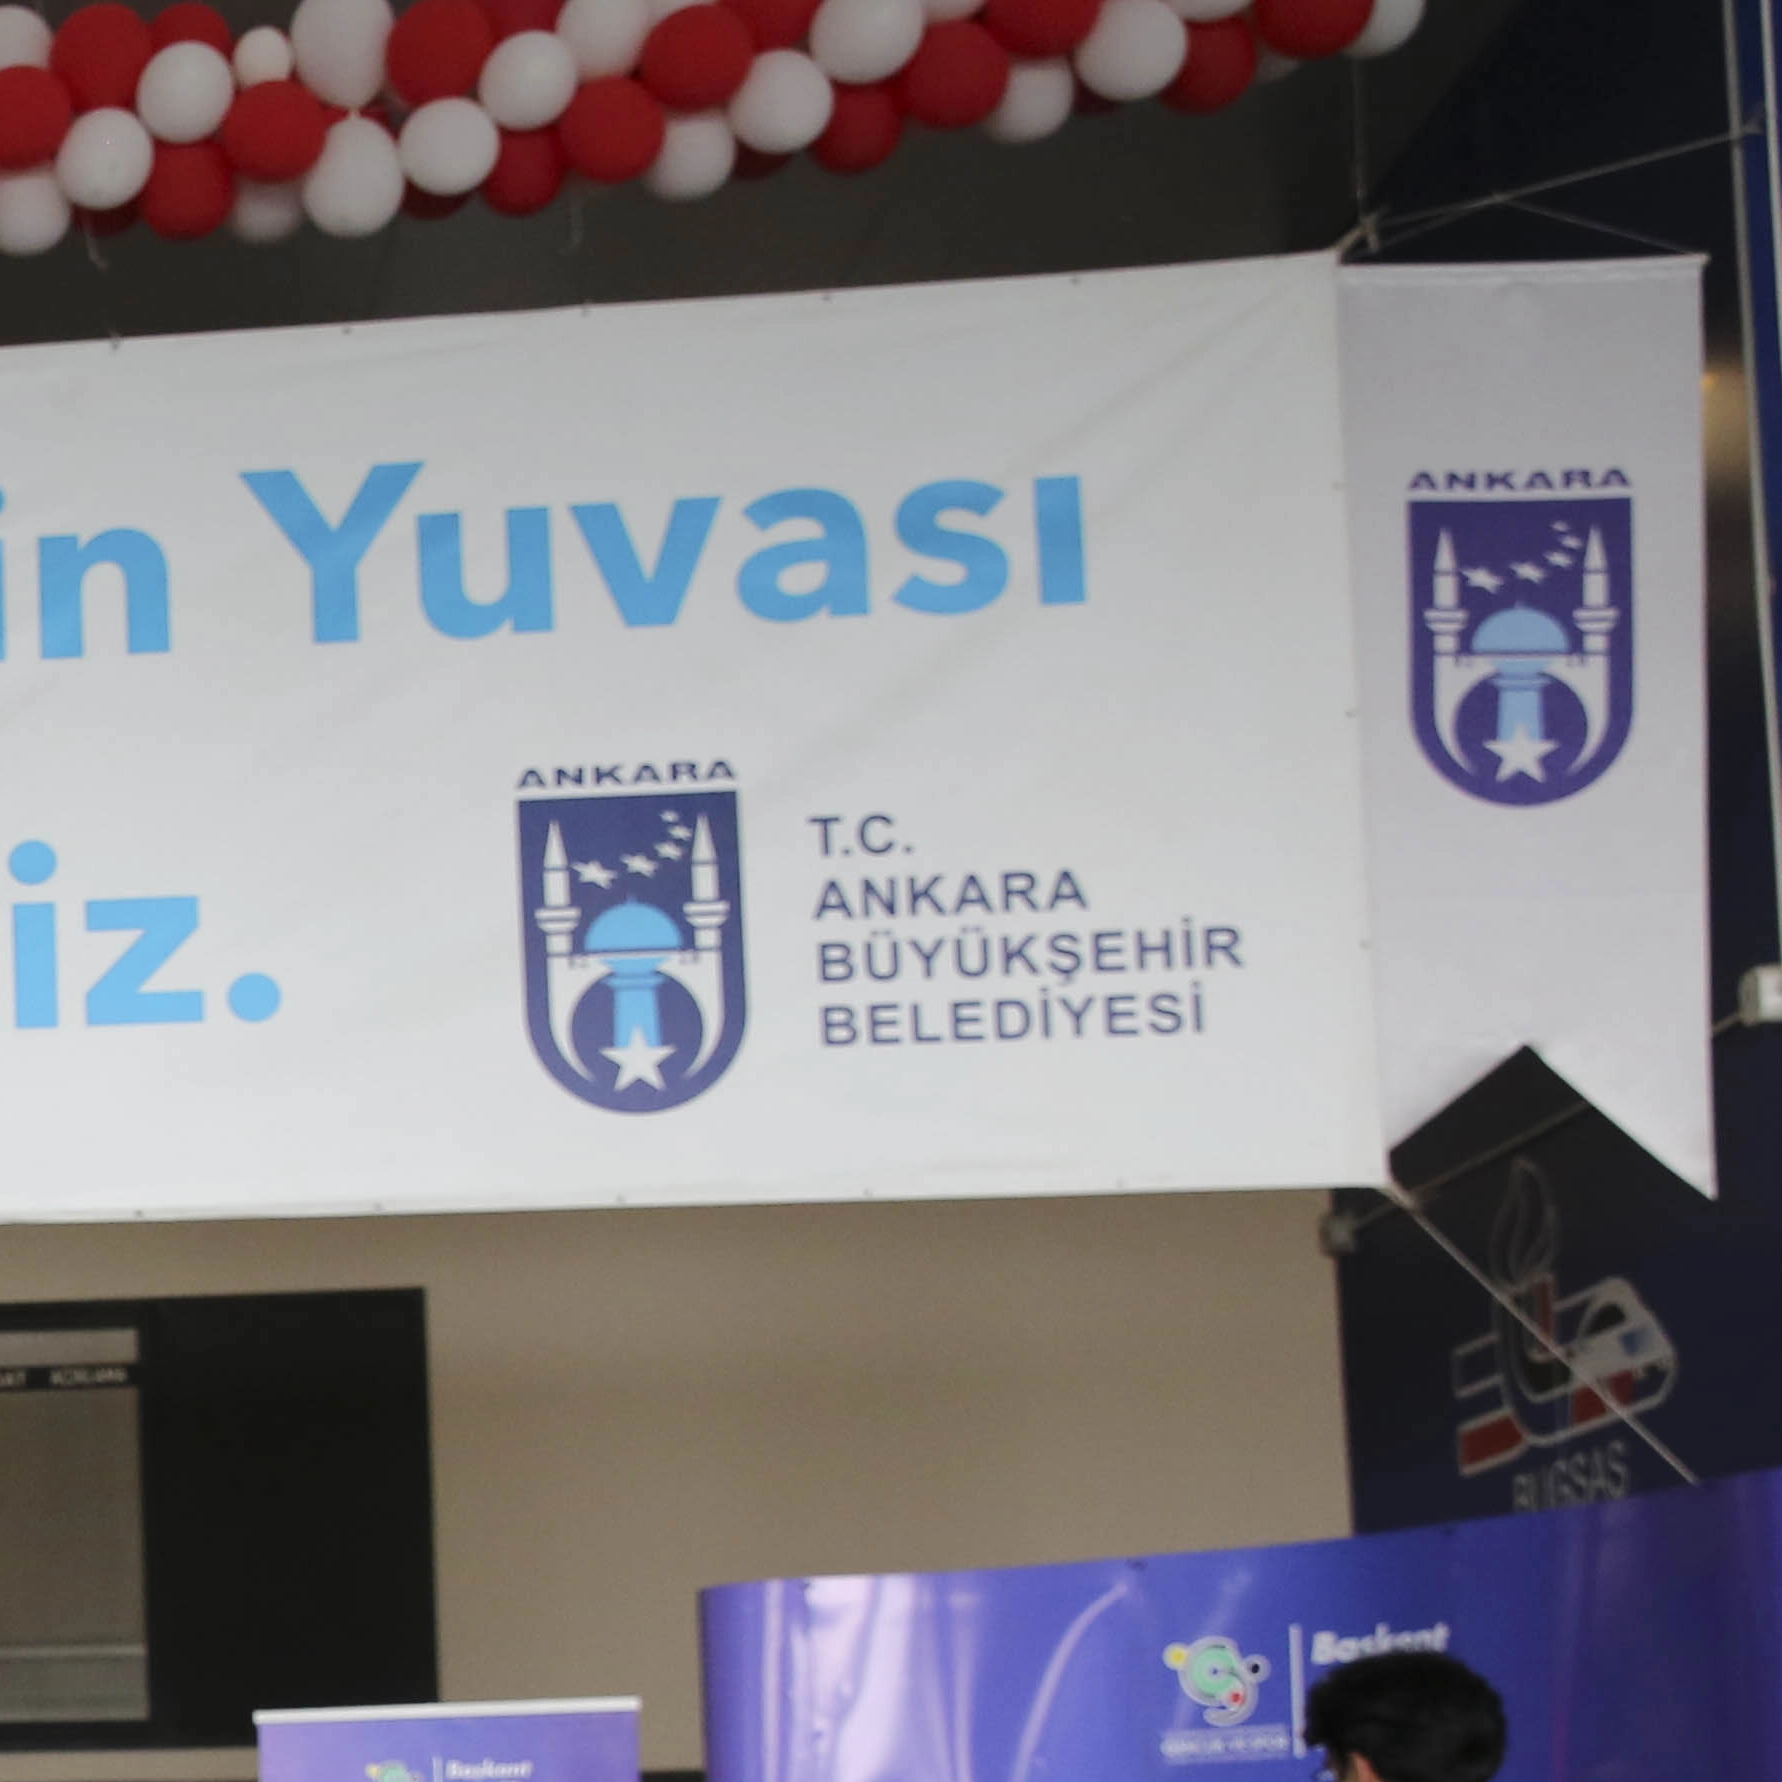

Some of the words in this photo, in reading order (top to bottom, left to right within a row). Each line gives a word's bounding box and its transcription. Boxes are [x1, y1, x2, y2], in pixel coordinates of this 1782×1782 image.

[1408, 466, 1631, 491] ANKARA
[239, 461, 1088, 645] Yuvası
[516, 759, 738, 790] ANKARA
[808, 814, 914, 858] T.C.
[815, 869, 1088, 921] ANKARA
[818, 917, 1244, 986] BÜYÜKŞEHİR
[822, 981, 1205, 1047] BELEDİYESİ
